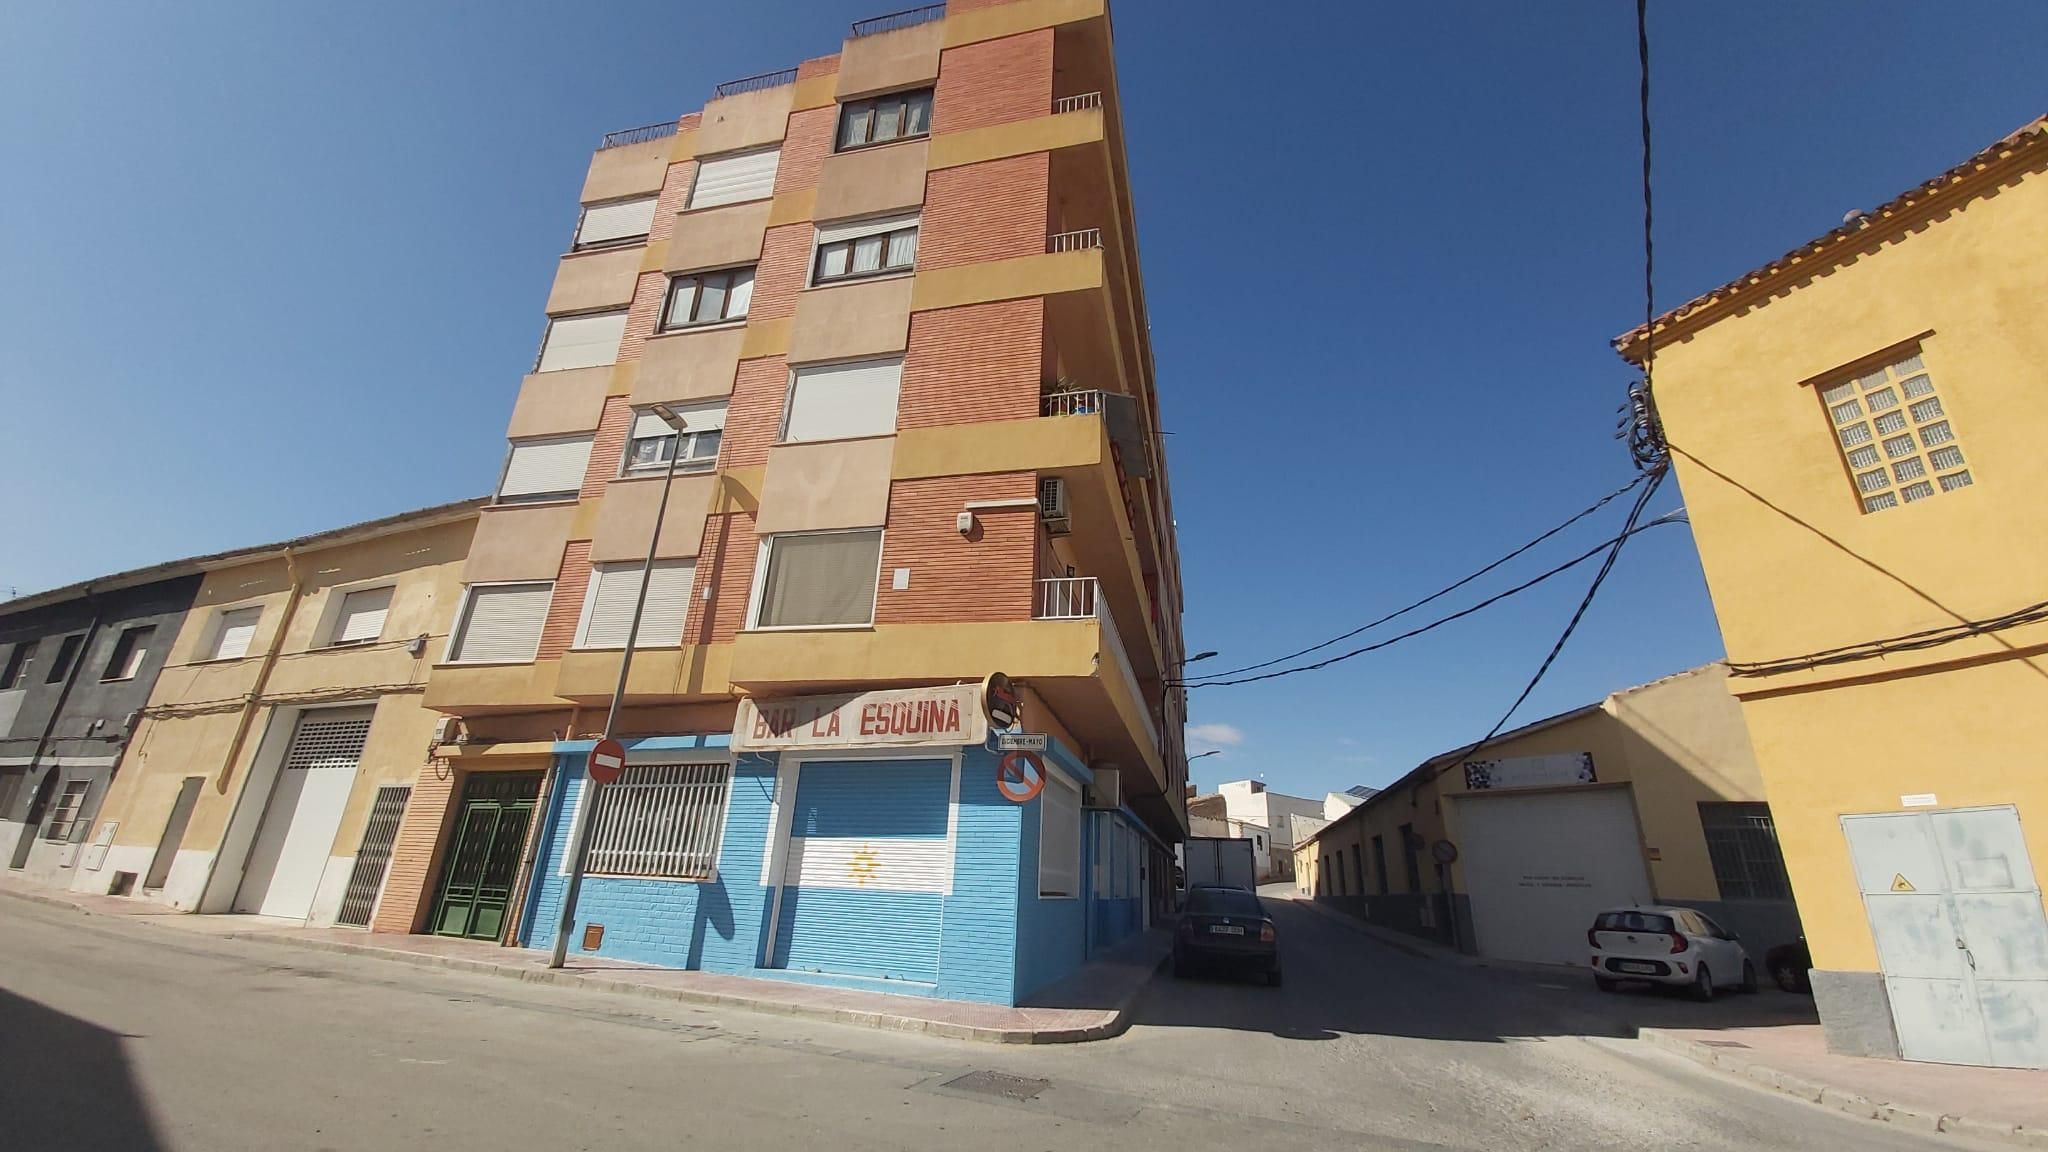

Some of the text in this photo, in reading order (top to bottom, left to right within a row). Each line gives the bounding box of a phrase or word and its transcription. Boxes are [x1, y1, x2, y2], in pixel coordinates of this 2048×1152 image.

[752, 699, 960, 739] BAR LA ESQUINA
